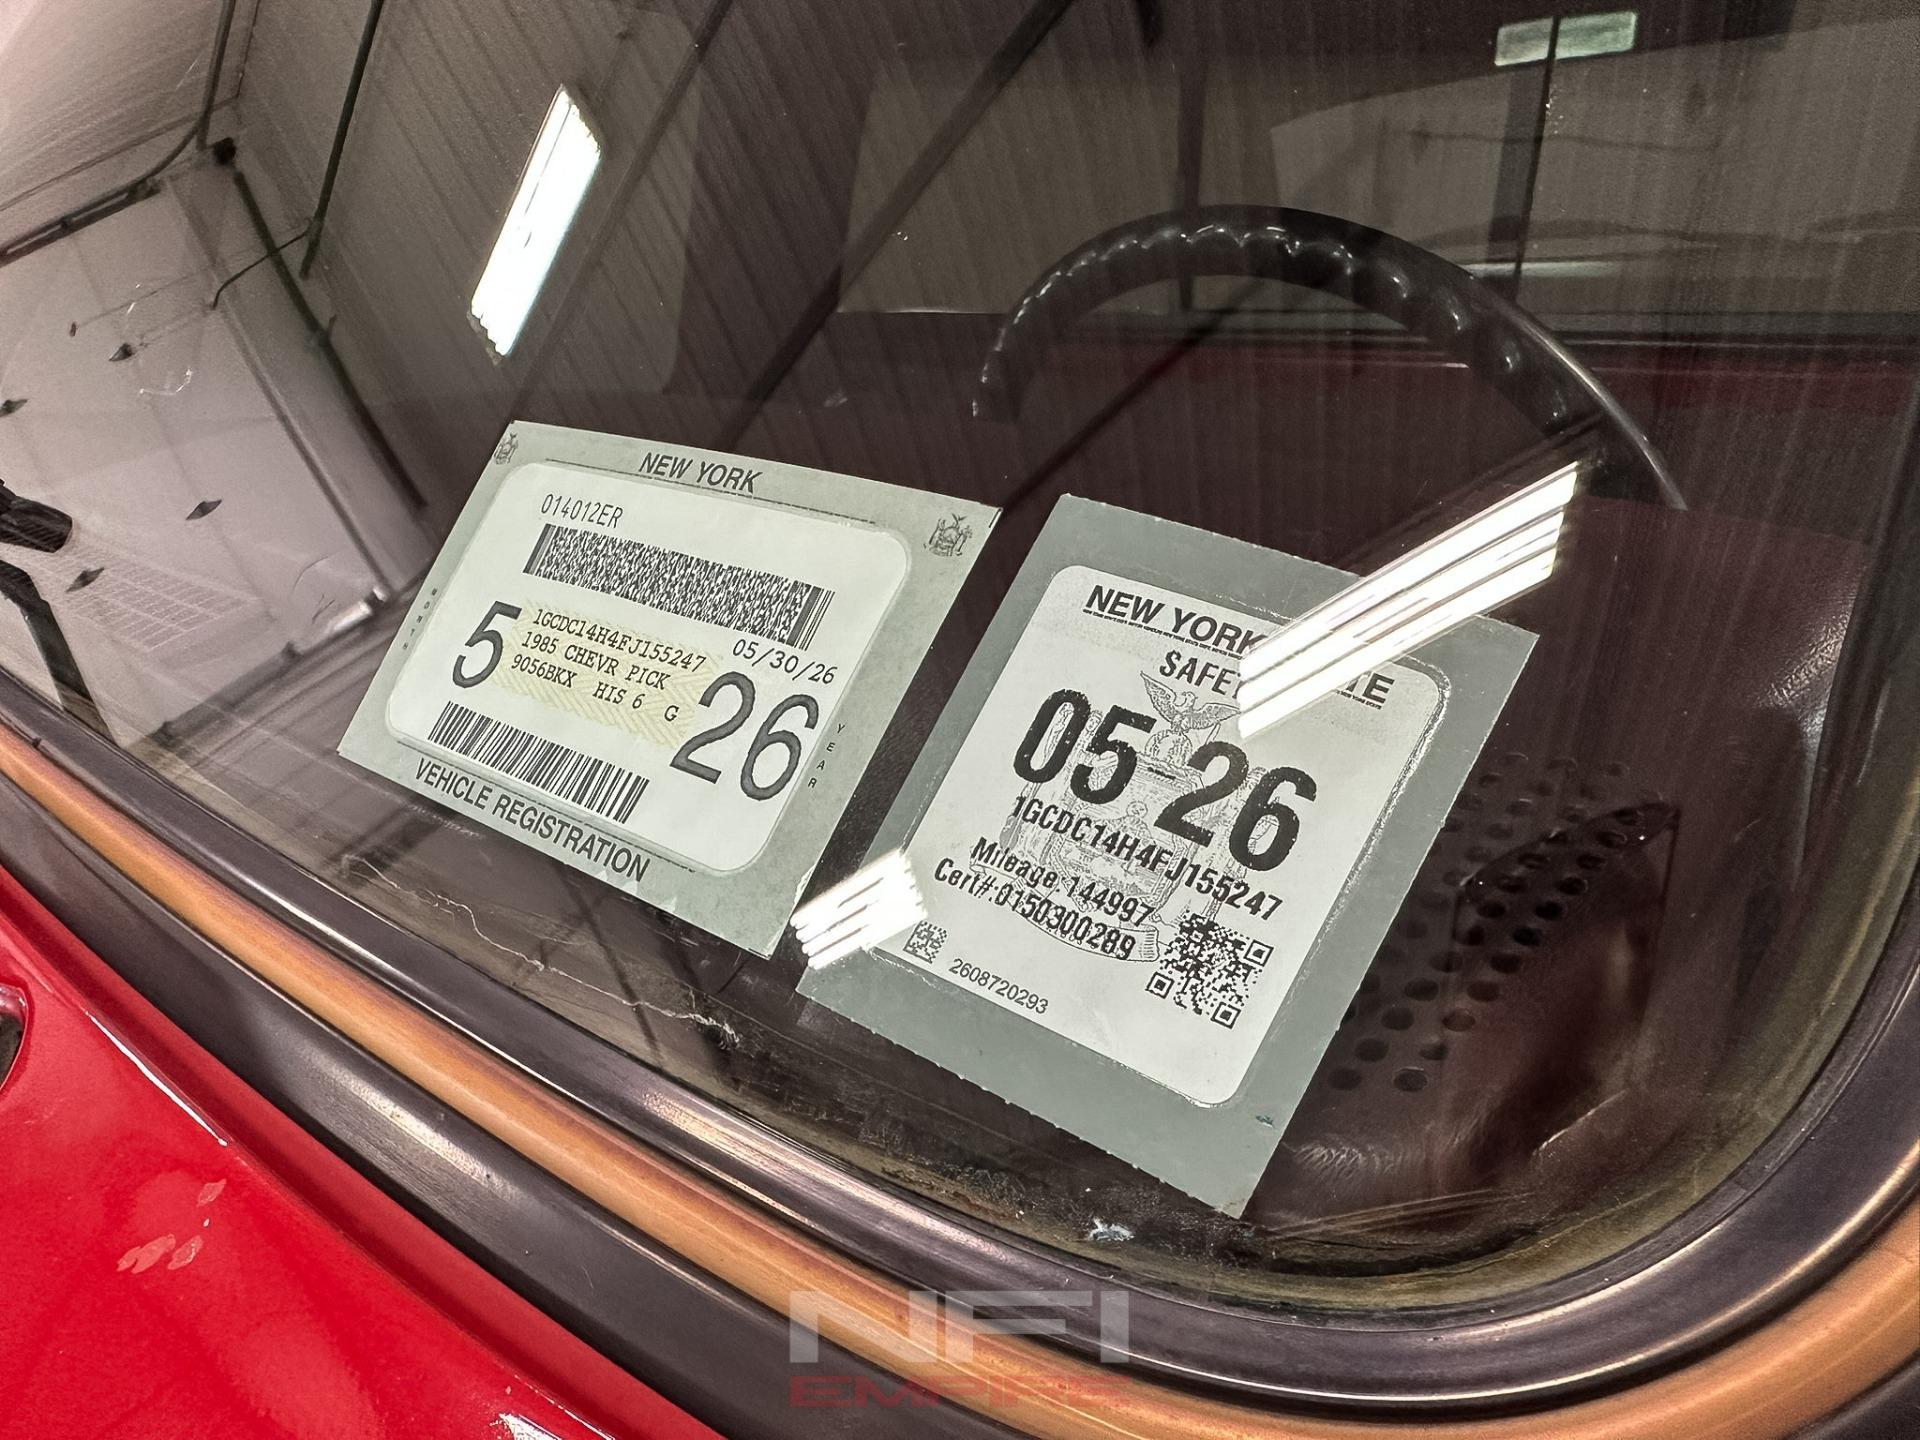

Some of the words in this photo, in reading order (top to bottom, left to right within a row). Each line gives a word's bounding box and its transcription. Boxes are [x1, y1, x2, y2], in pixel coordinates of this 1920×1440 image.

[638, 452, 693, 479] NEW
[696, 460, 763, 493] YORK
[541, 493, 624, 528] 014012ER
[452, 600, 522, 688] 5
[533, 609, 707, 673] 1GCDC14H4FJ155247
[1085, 584, 1166, 624] NEW
[1171, 606, 1269, 655] YORK
[511, 653, 578, 689] 9056BKX
[593, 681, 628, 705] HIS
[631, 693, 643, 709] 6
[664, 704, 680, 722] G
[521, 631, 559, 655] 1985
[564, 644, 620, 676] CHEVR
[625, 665, 671, 691] PICK
[732, 638, 838, 685] 05/30/26
[669, 670, 820, 801] 26
[807, 723, 845, 789] YEAR
[1013, 688, 1158, 805] 05
[1153, 740, 1318, 872] 26
[415, 757, 493, 810] VEHICLE
[491, 793, 651, 883] REGISTRATION
[1011, 795, 1284, 921] 1GCDC14H4FJ155247
[948, 957, 1050, 1015] 2608720293
